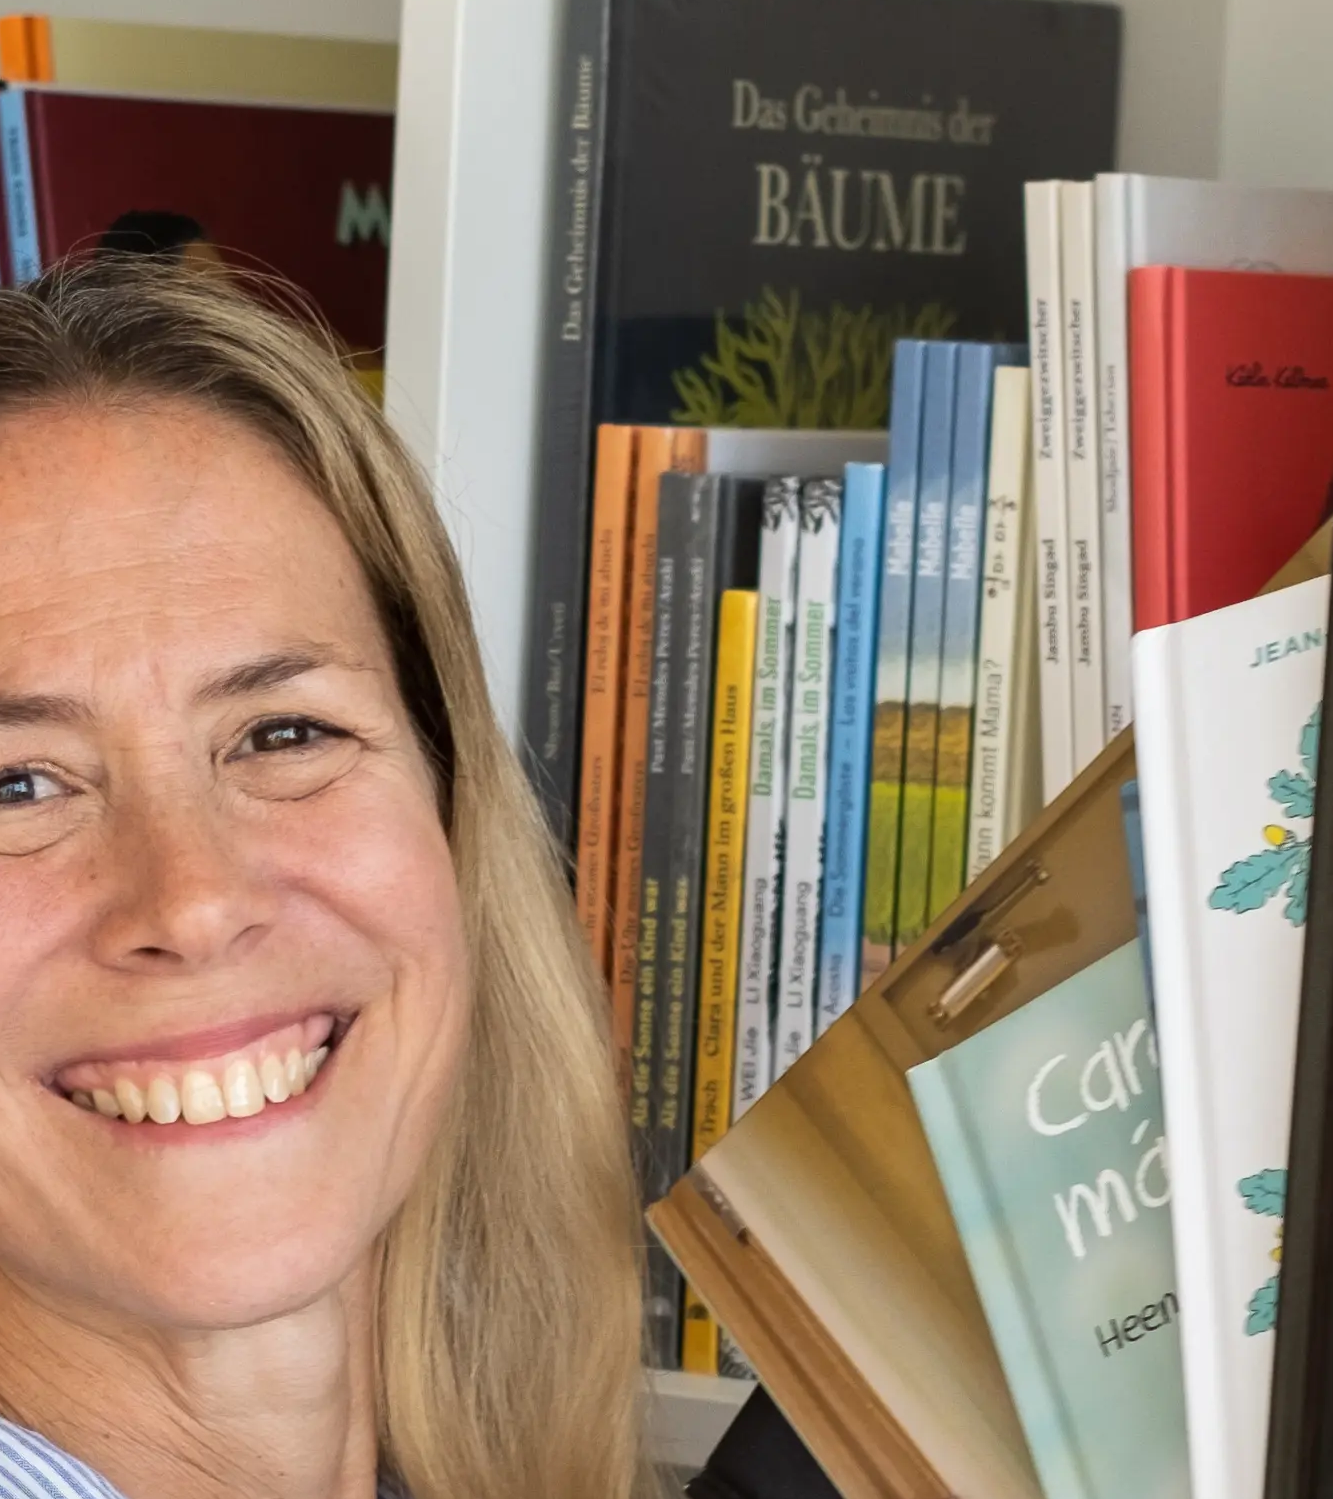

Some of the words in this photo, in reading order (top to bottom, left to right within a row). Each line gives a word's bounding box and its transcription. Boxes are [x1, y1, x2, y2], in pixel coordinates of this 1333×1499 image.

[731, 78, 788, 132] Das
[793, 88, 943, 145] Geheimnis
[948, 99, 997, 146] der
[570, 137, 592, 174] der
[753, 153, 968, 256] BÄUME
[561, 302, 584, 343] Das
[887, 500, 915, 578] Mabelle
[918, 501, 945, 579] Mabelle
[949, 504, 977, 582] Mabelle
[756, 596, 782, 681] Sommer
[1247, 628, 1324, 670] JEAN
[720, 683, 741, 738] Haus
[756, 686, 780, 715] im
[978, 658, 1004, 740] Mama?
[714, 742, 739, 816] großen
[974, 743, 1000, 820] kommt
[714, 820, 733, 847] im
[708, 853, 731, 913] Mann
[638, 917, 660, 961] Kind
[706, 917, 727, 954] der
[746, 876, 770, 983] Xiaoguang
[636, 964, 657, 996] ein
[703, 960, 725, 998] und
[745, 984, 762, 1006] LI
[633, 998, 656, 1060] Sonne
[701, 1002, 723, 1057] Clara
[631, 1063, 653, 1094] die
[1025, 1017, 1160, 1138] Car
[629, 1096, 652, 1130] Als
